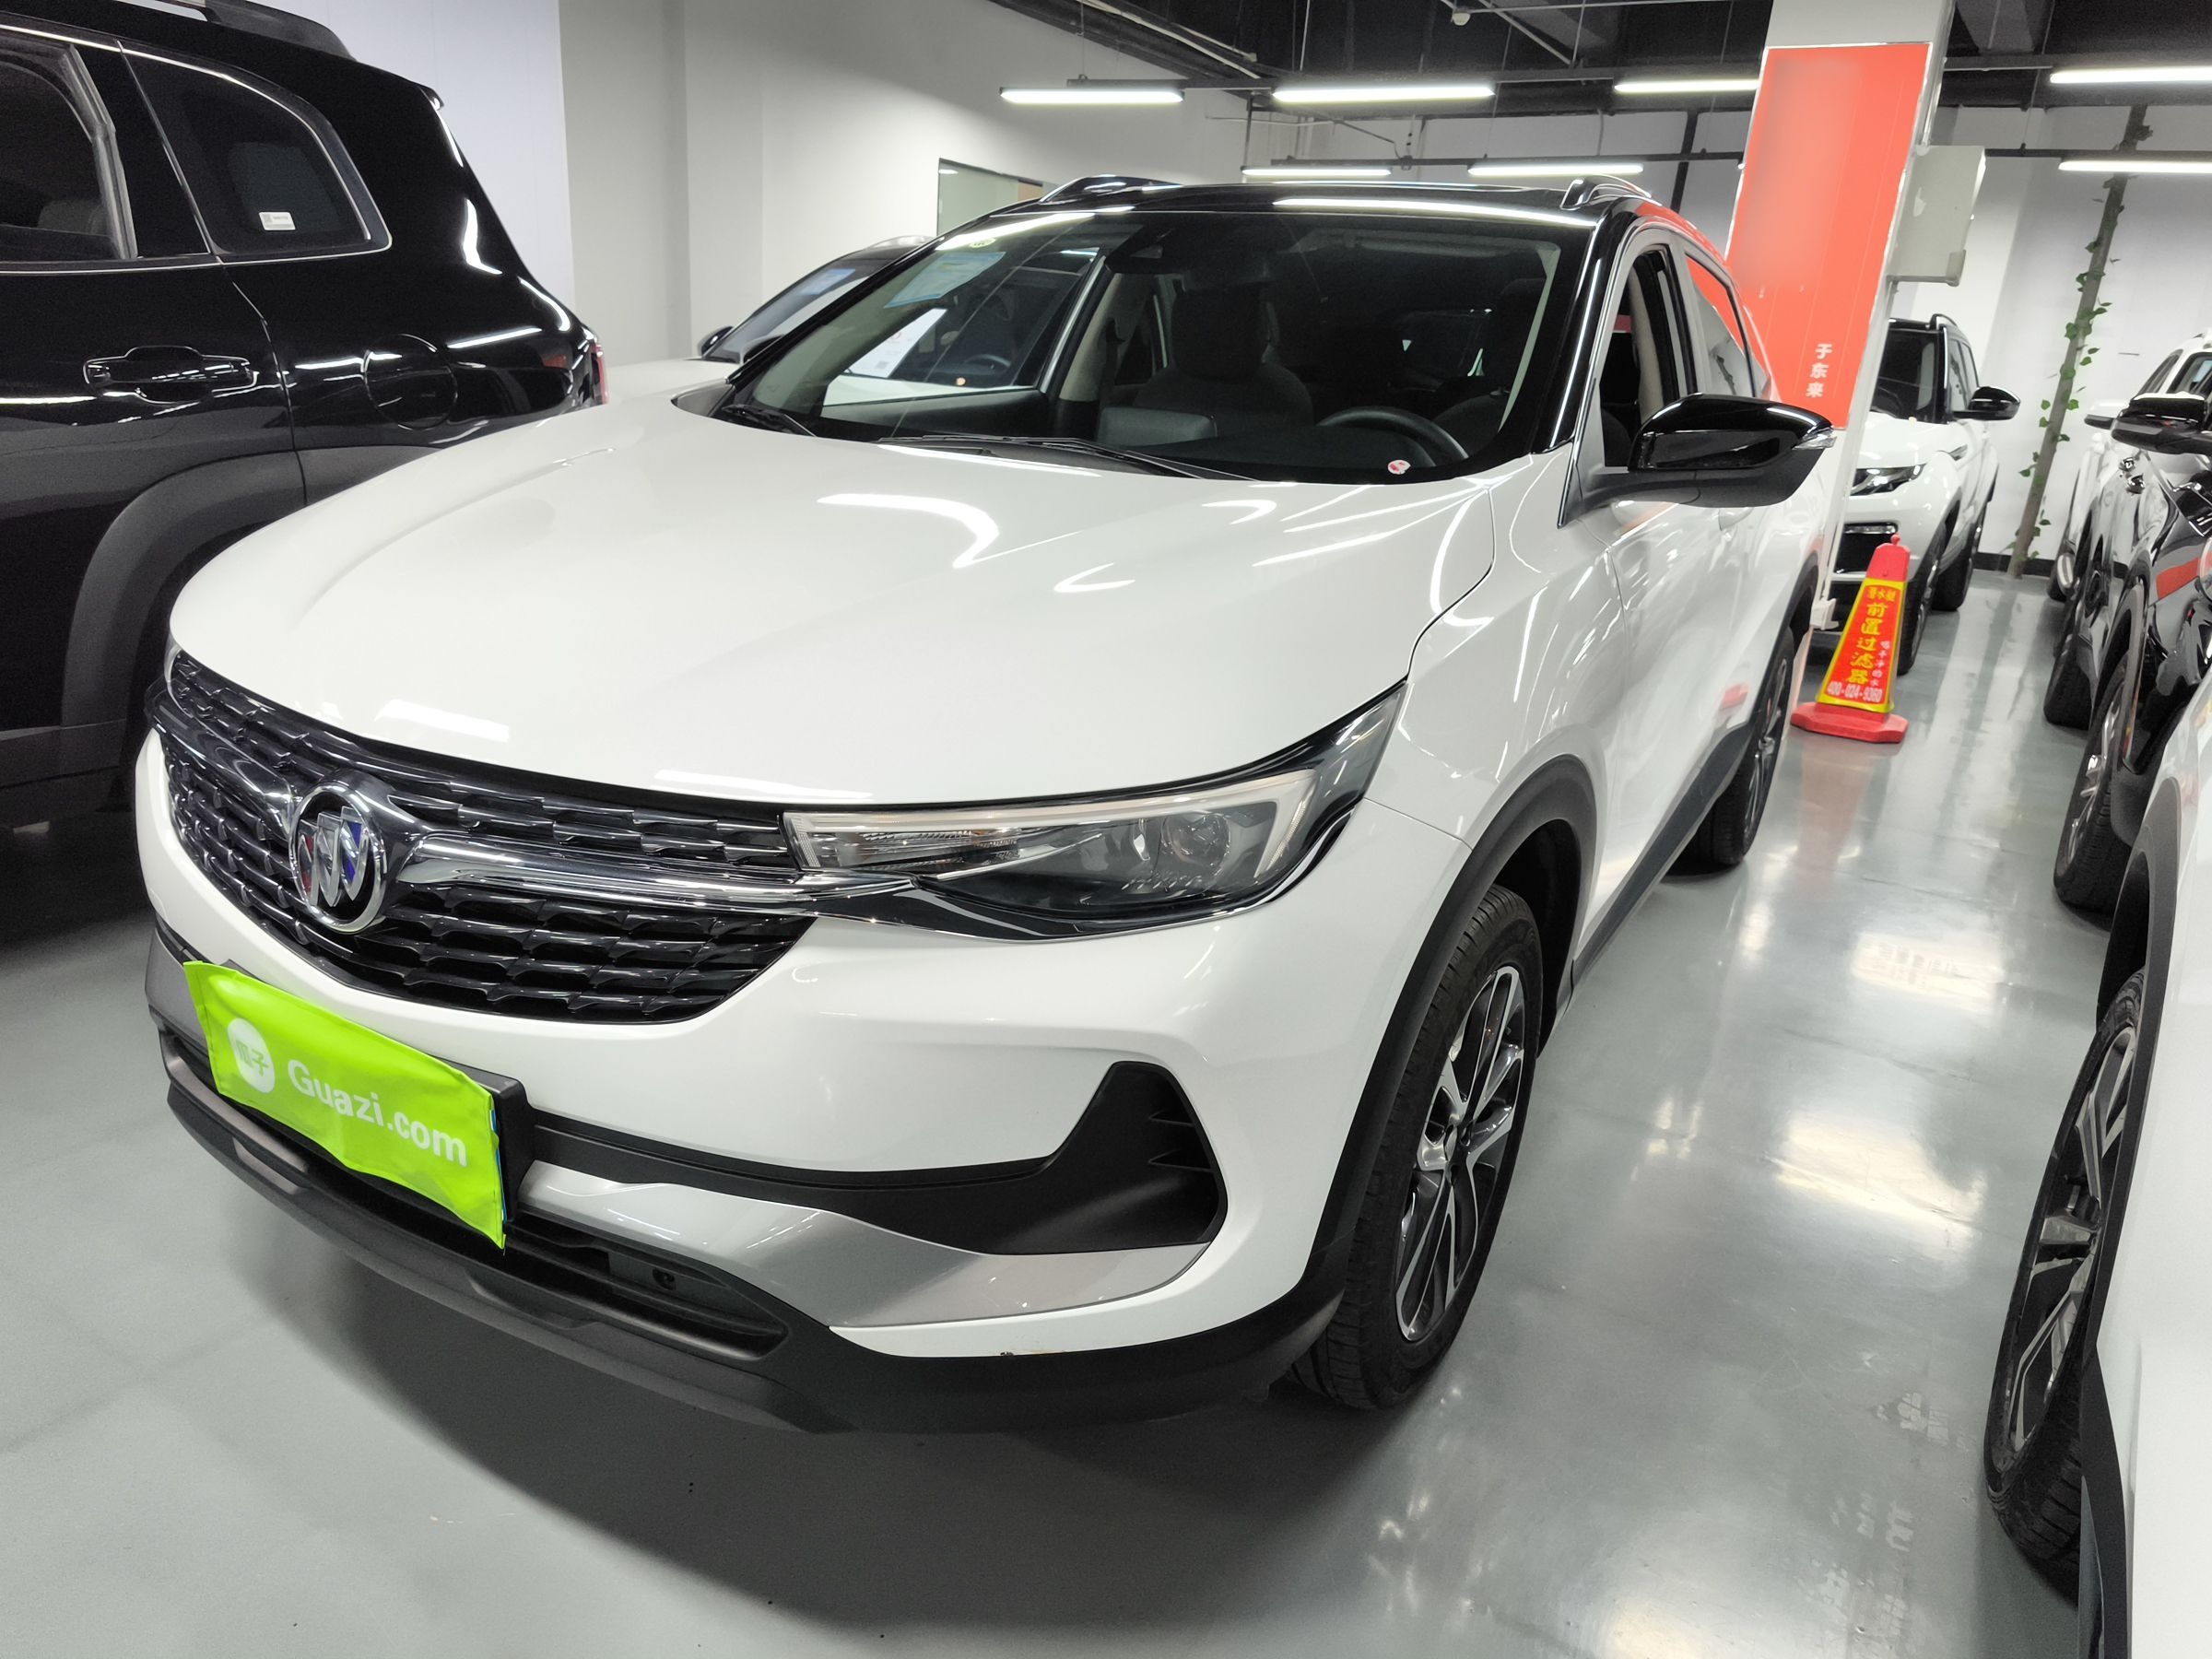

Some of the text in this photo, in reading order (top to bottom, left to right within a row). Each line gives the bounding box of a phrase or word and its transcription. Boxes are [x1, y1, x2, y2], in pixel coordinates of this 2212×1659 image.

[1806, 343, 1833, 398] 于东来
[1846, 602, 1888, 686] 前置过滤器
[235, 1039, 269, 1077] 瓜子
[288, 1059, 468, 1168] Guazi.com
